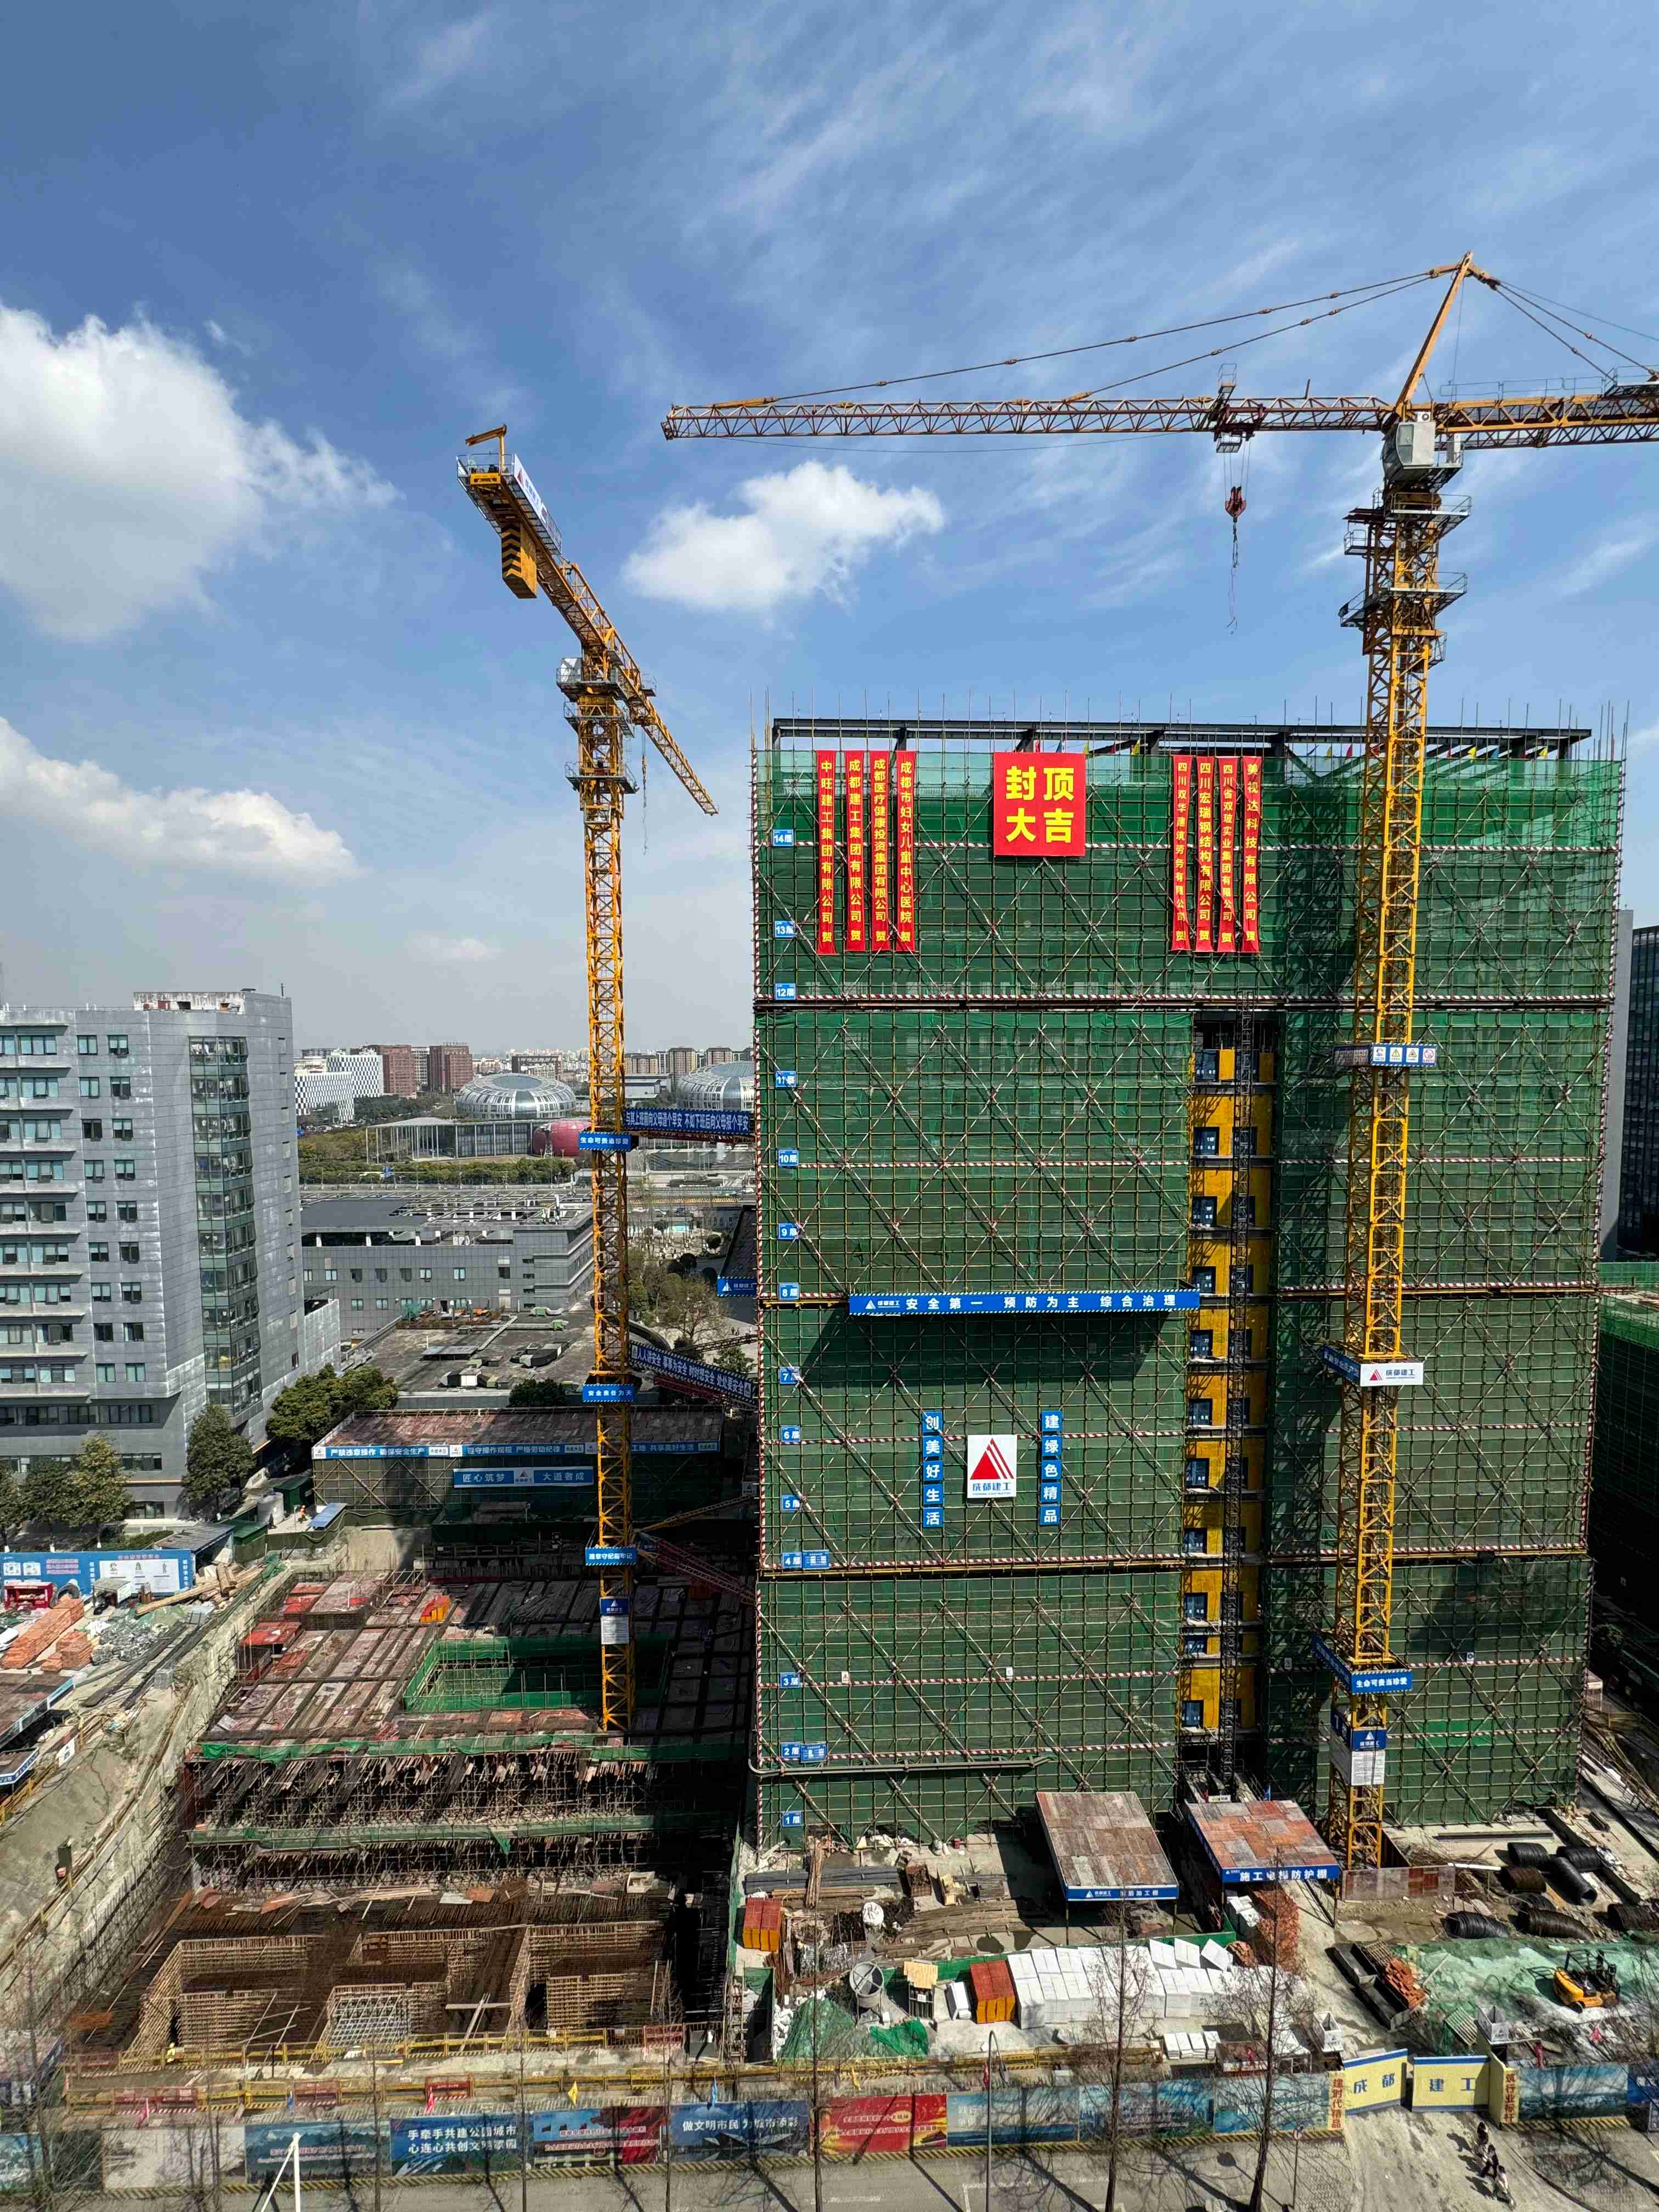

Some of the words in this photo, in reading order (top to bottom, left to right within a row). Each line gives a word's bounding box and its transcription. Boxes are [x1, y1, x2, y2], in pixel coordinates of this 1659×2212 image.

[1006, 765, 1075, 802] 封顶
[1005, 808, 1074, 843] 大吉
[774, 834, 793, 844] 14层
[821, 760, 833, 924] 中旺建工集团有限公司
[849, 759, 862, 922] 成都建工集团有限公司
[873, 759, 887, 922] 成都医疗健康投资集团有限公司
[900, 761, 912, 923] 成都市妇女儿童中心医院
[1175, 763, 1187, 922] 四川双华建筑劳务有限公司
[1199, 763, 1212, 921] 四川宏瑞钢结构有限公司
[1245, 763, 1259, 921] 美视达科技有限公司
[776, 926, 794, 935] 13层
[851, 930, 861, 941] 贺
[876, 931, 887, 941] 贺
[901, 931, 911, 941] 贺
[1176, 930, 1186, 941] 贺
[1199, 930, 1210, 940] 贺
[1246, 931, 1256, 941] 贺
[822, 932, 832, 942] 贺
[1221, 933, 1232, 943] 贺
[776, 988, 795, 997] 12层
[779, 1154, 798, 1164] 10层
[782, 1288, 798, 1297] 8层
[906, 1297, 983, 1310] 安全第一
[1004, 1296, 1079, 1308] 预防为主
[1100, 1295, 1176, 1307] 综合治理
[783, 1430, 799, 1440] 6层
[926, 1415, 940, 1525] 创美好生活
[1043, 1415, 1059, 1522] 建绿色精品
[462, 1474, 505, 1483] 匠心筑梦
[973, 1482, 1011, 1491] 成都建工
[785, 1556, 800, 1566] 4层
[783, 1677, 798, 1686] 3层
[1356, 1677, 1407, 1688] 生命可贵当珍爱
[784, 1747, 799, 1756] 2层
[785, 1816, 800, 1824] 1层
[1353, 2072, 1395, 2094] 成都
[1429, 2078, 1475, 2093] 建工
[682, 2119, 738, 2131] 做文明市民
[408, 2125, 517, 2140] 手牵手共建公园城市
[408, 2139, 517, 2154] 心连心共创文明家园
